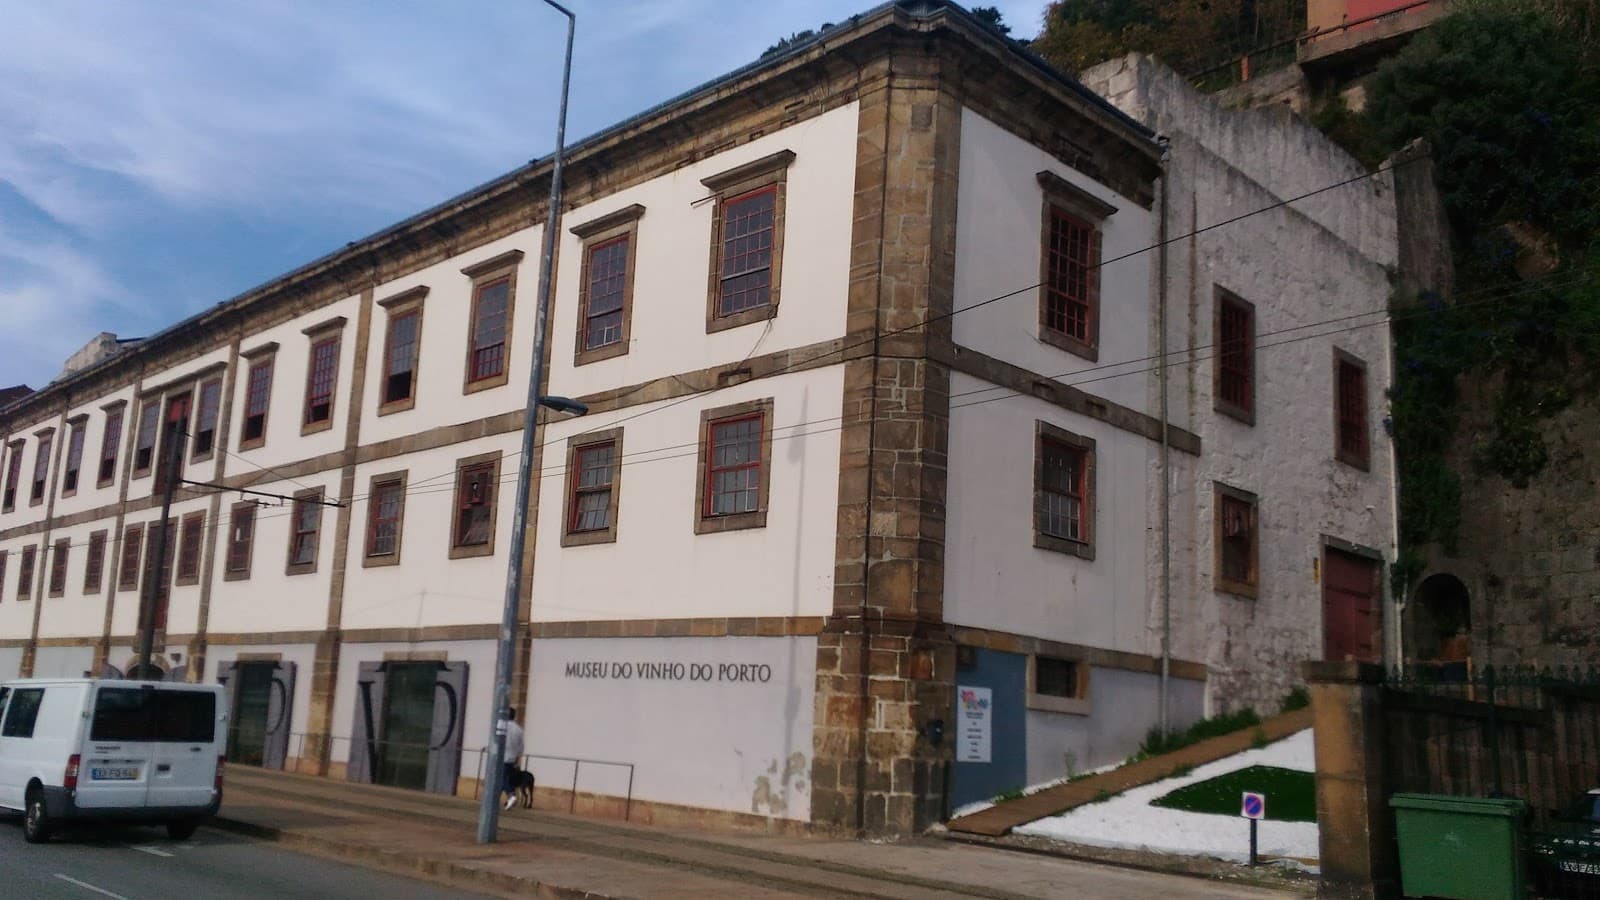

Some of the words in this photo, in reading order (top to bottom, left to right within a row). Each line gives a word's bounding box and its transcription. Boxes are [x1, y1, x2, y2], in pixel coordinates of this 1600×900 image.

[565, 662, 608, 679] MUSEU
[611, 662, 633, 679] DO
[636, 662, 685, 681] VINHO
[690, 663, 713, 681] DO
[718, 664, 771, 683] PORTO
